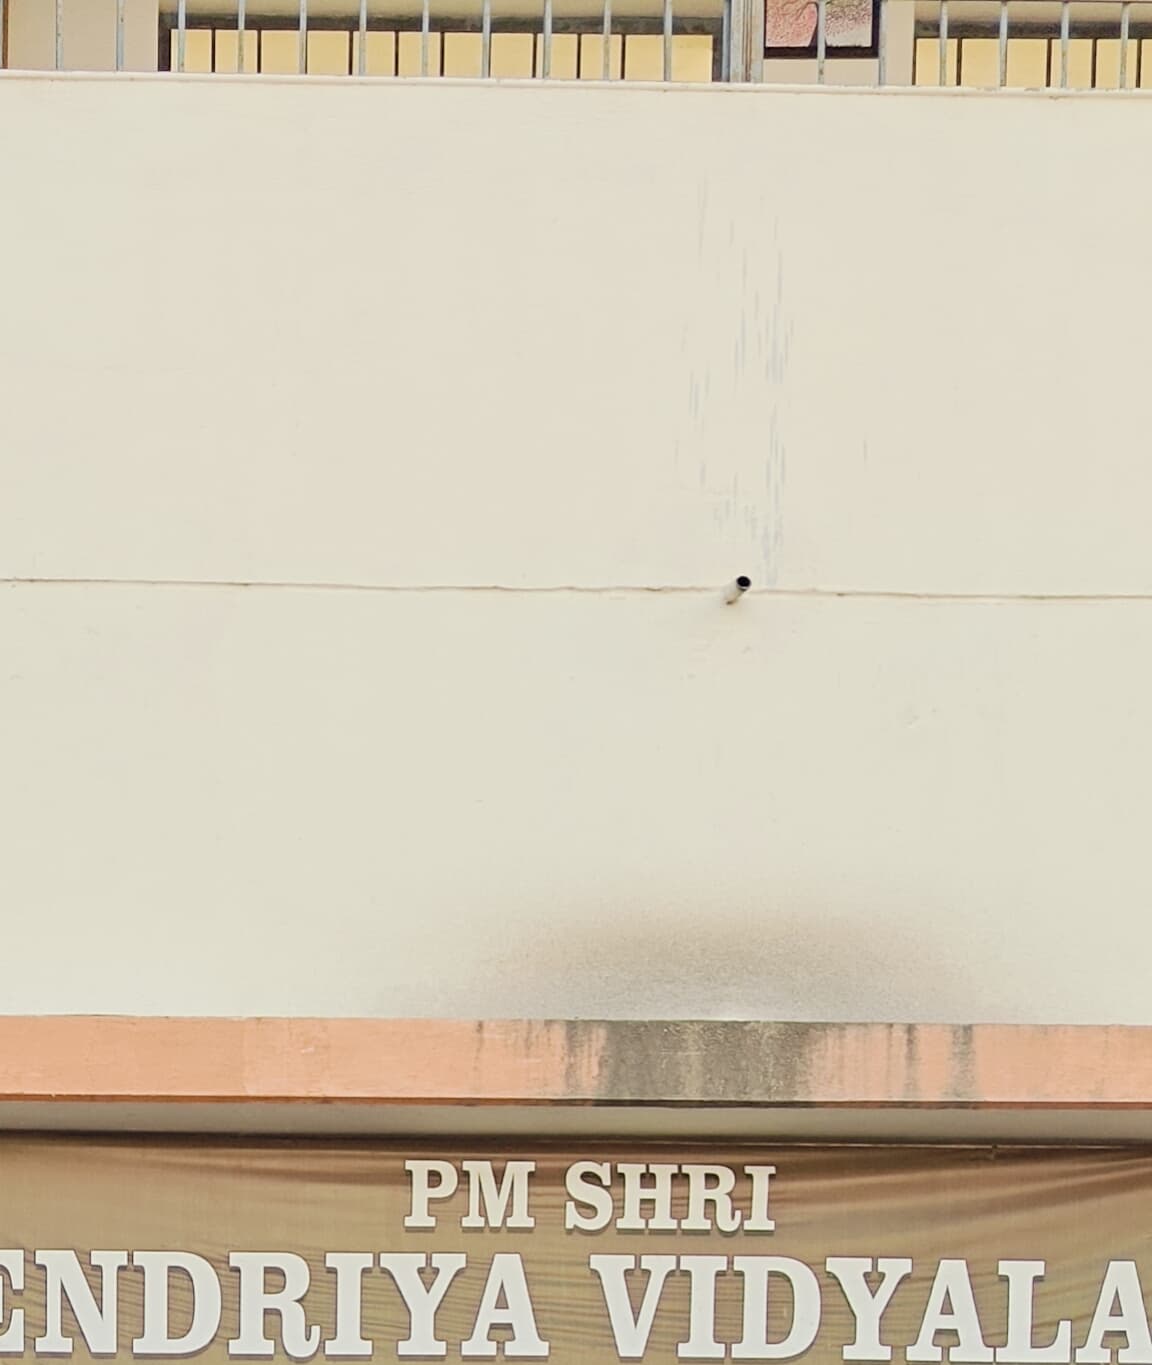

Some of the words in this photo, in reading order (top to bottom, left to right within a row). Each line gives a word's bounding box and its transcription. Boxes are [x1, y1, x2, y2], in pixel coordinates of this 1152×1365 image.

[404, 1160, 536, 1229] PM
[564, 1161, 776, 1232] SHRI
[589, 1254, 1152, 1364] VIDYALA
